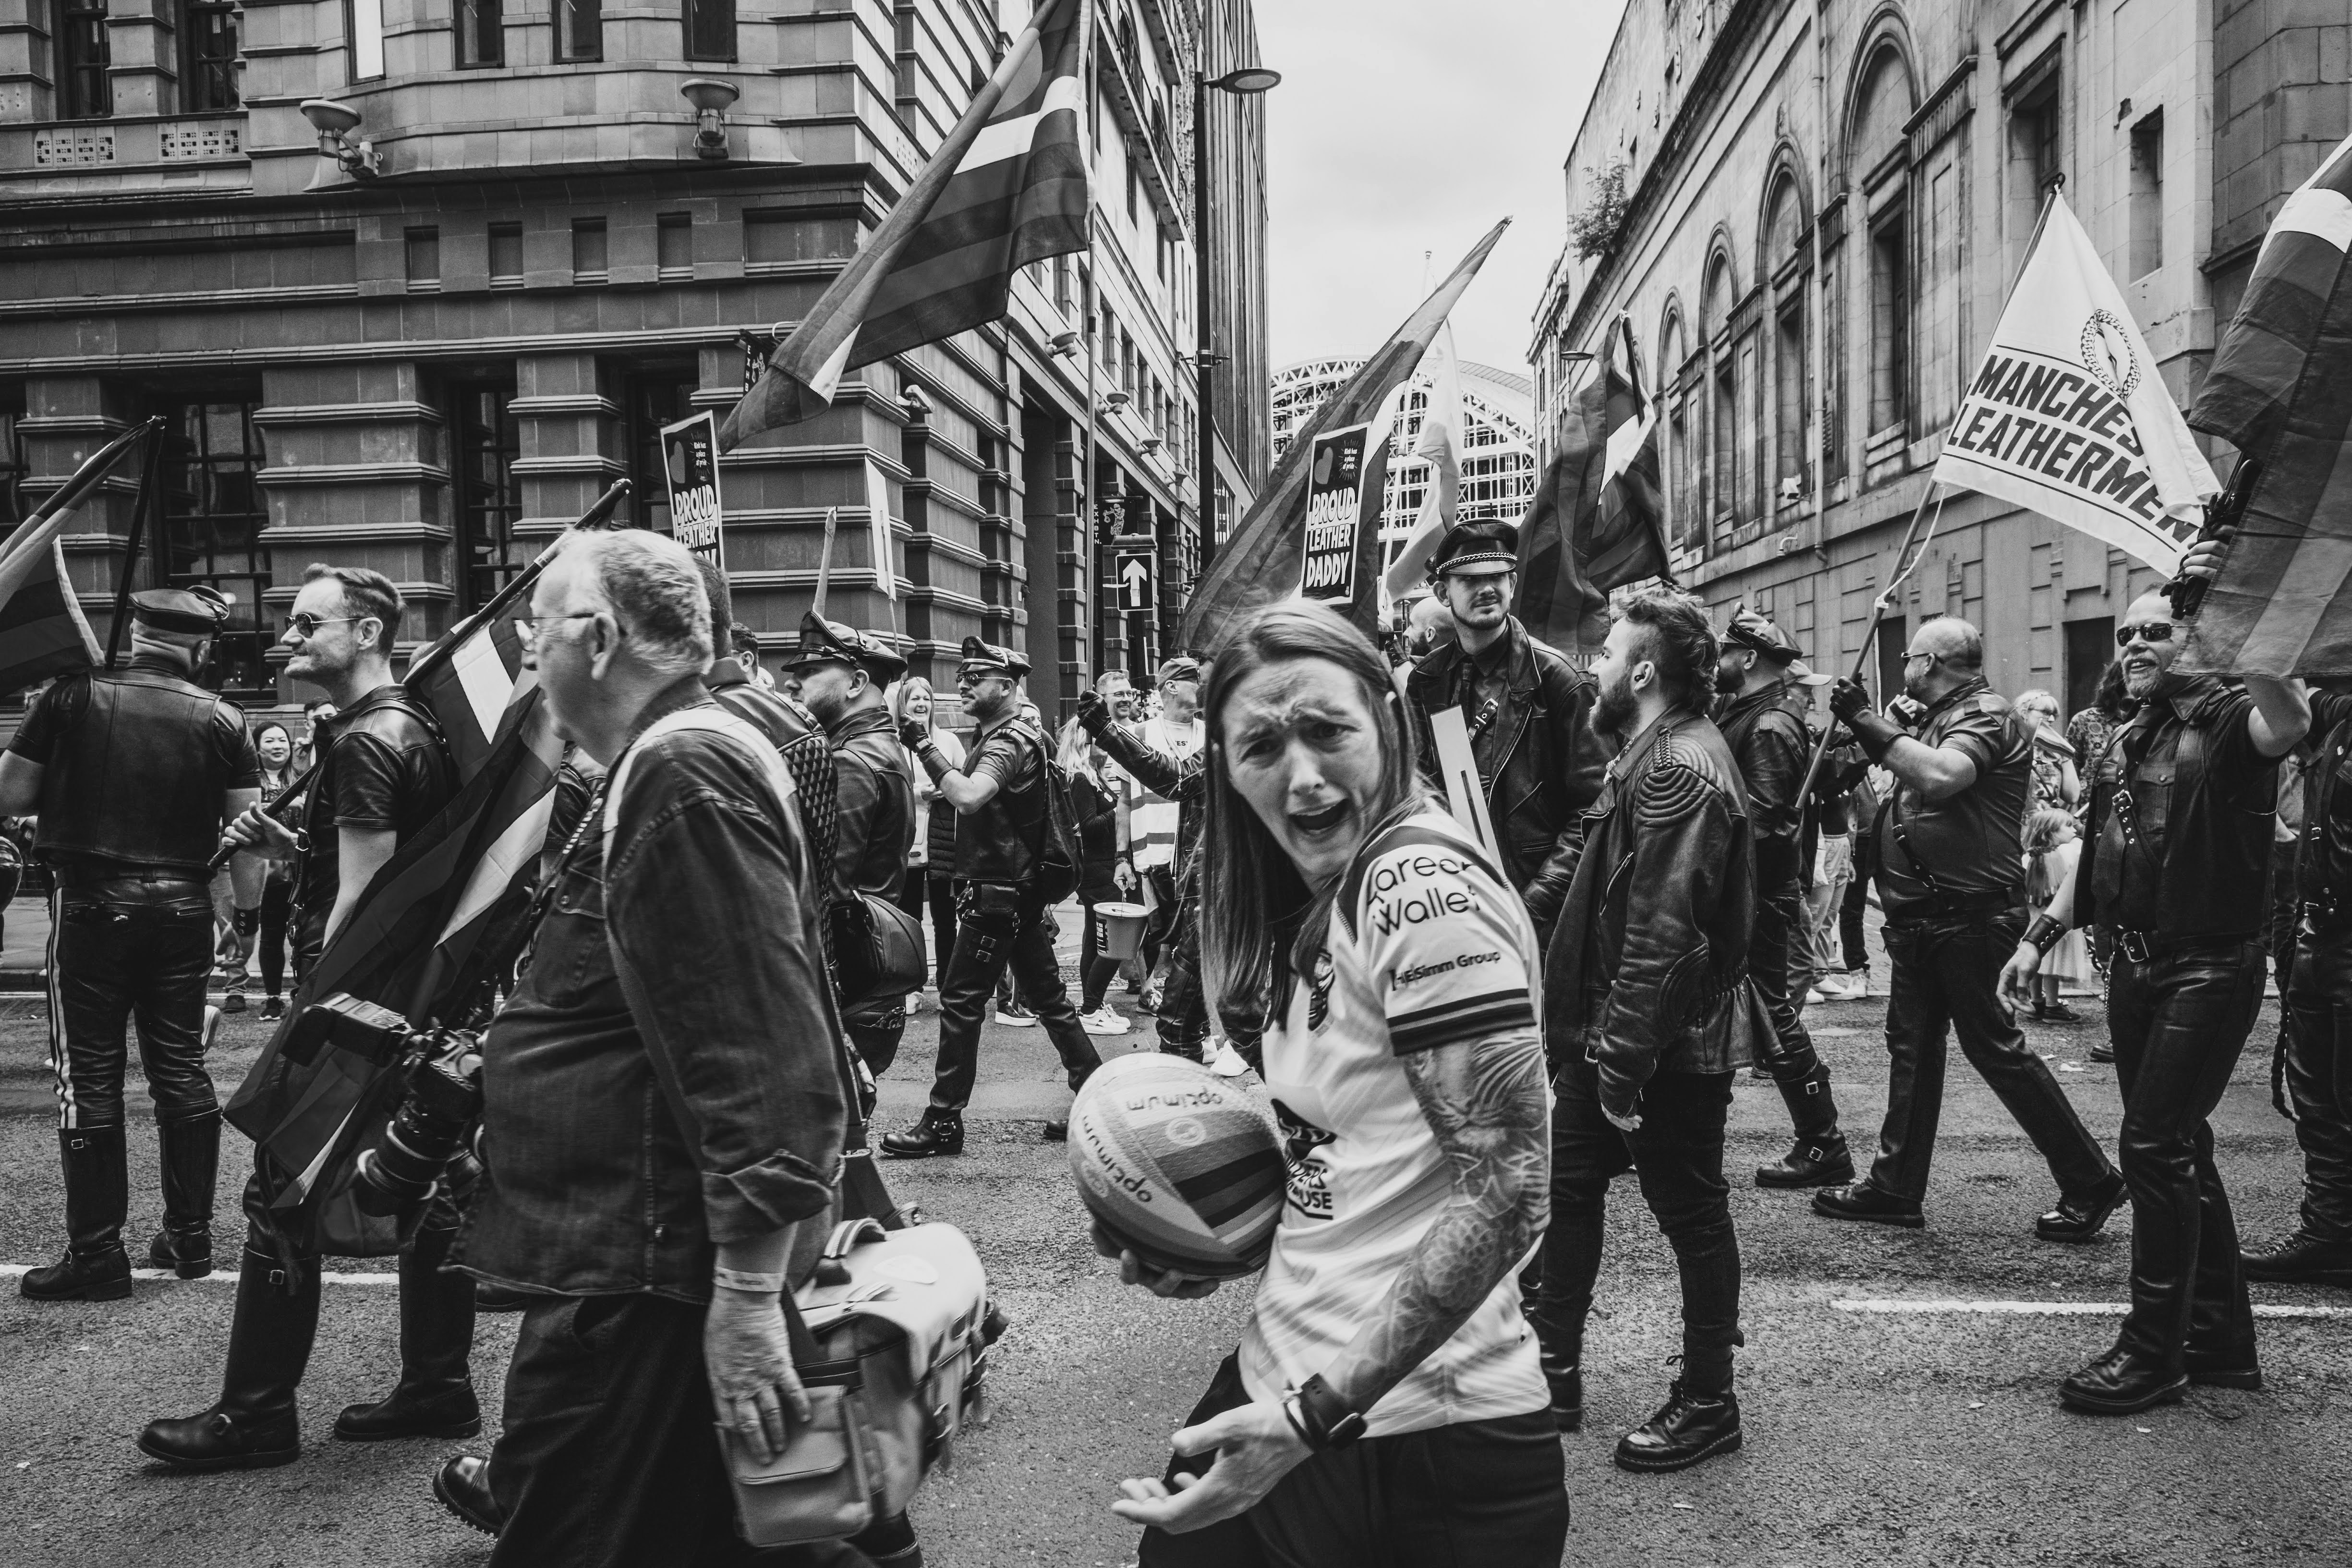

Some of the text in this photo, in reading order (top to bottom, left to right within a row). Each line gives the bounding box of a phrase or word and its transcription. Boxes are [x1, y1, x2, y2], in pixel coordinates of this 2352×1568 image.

[1970, 354, 2145, 458] MANCHES
[675, 484, 715, 524] PROUD
[1311, 487, 1355, 524] PROUD
[1309, 523, 1351, 552] LEATHER
[1306, 552, 1350, 587] DADDY
[1456, 951, 1501, 968] Group
[1083, 1115, 1152, 1203] optimum
